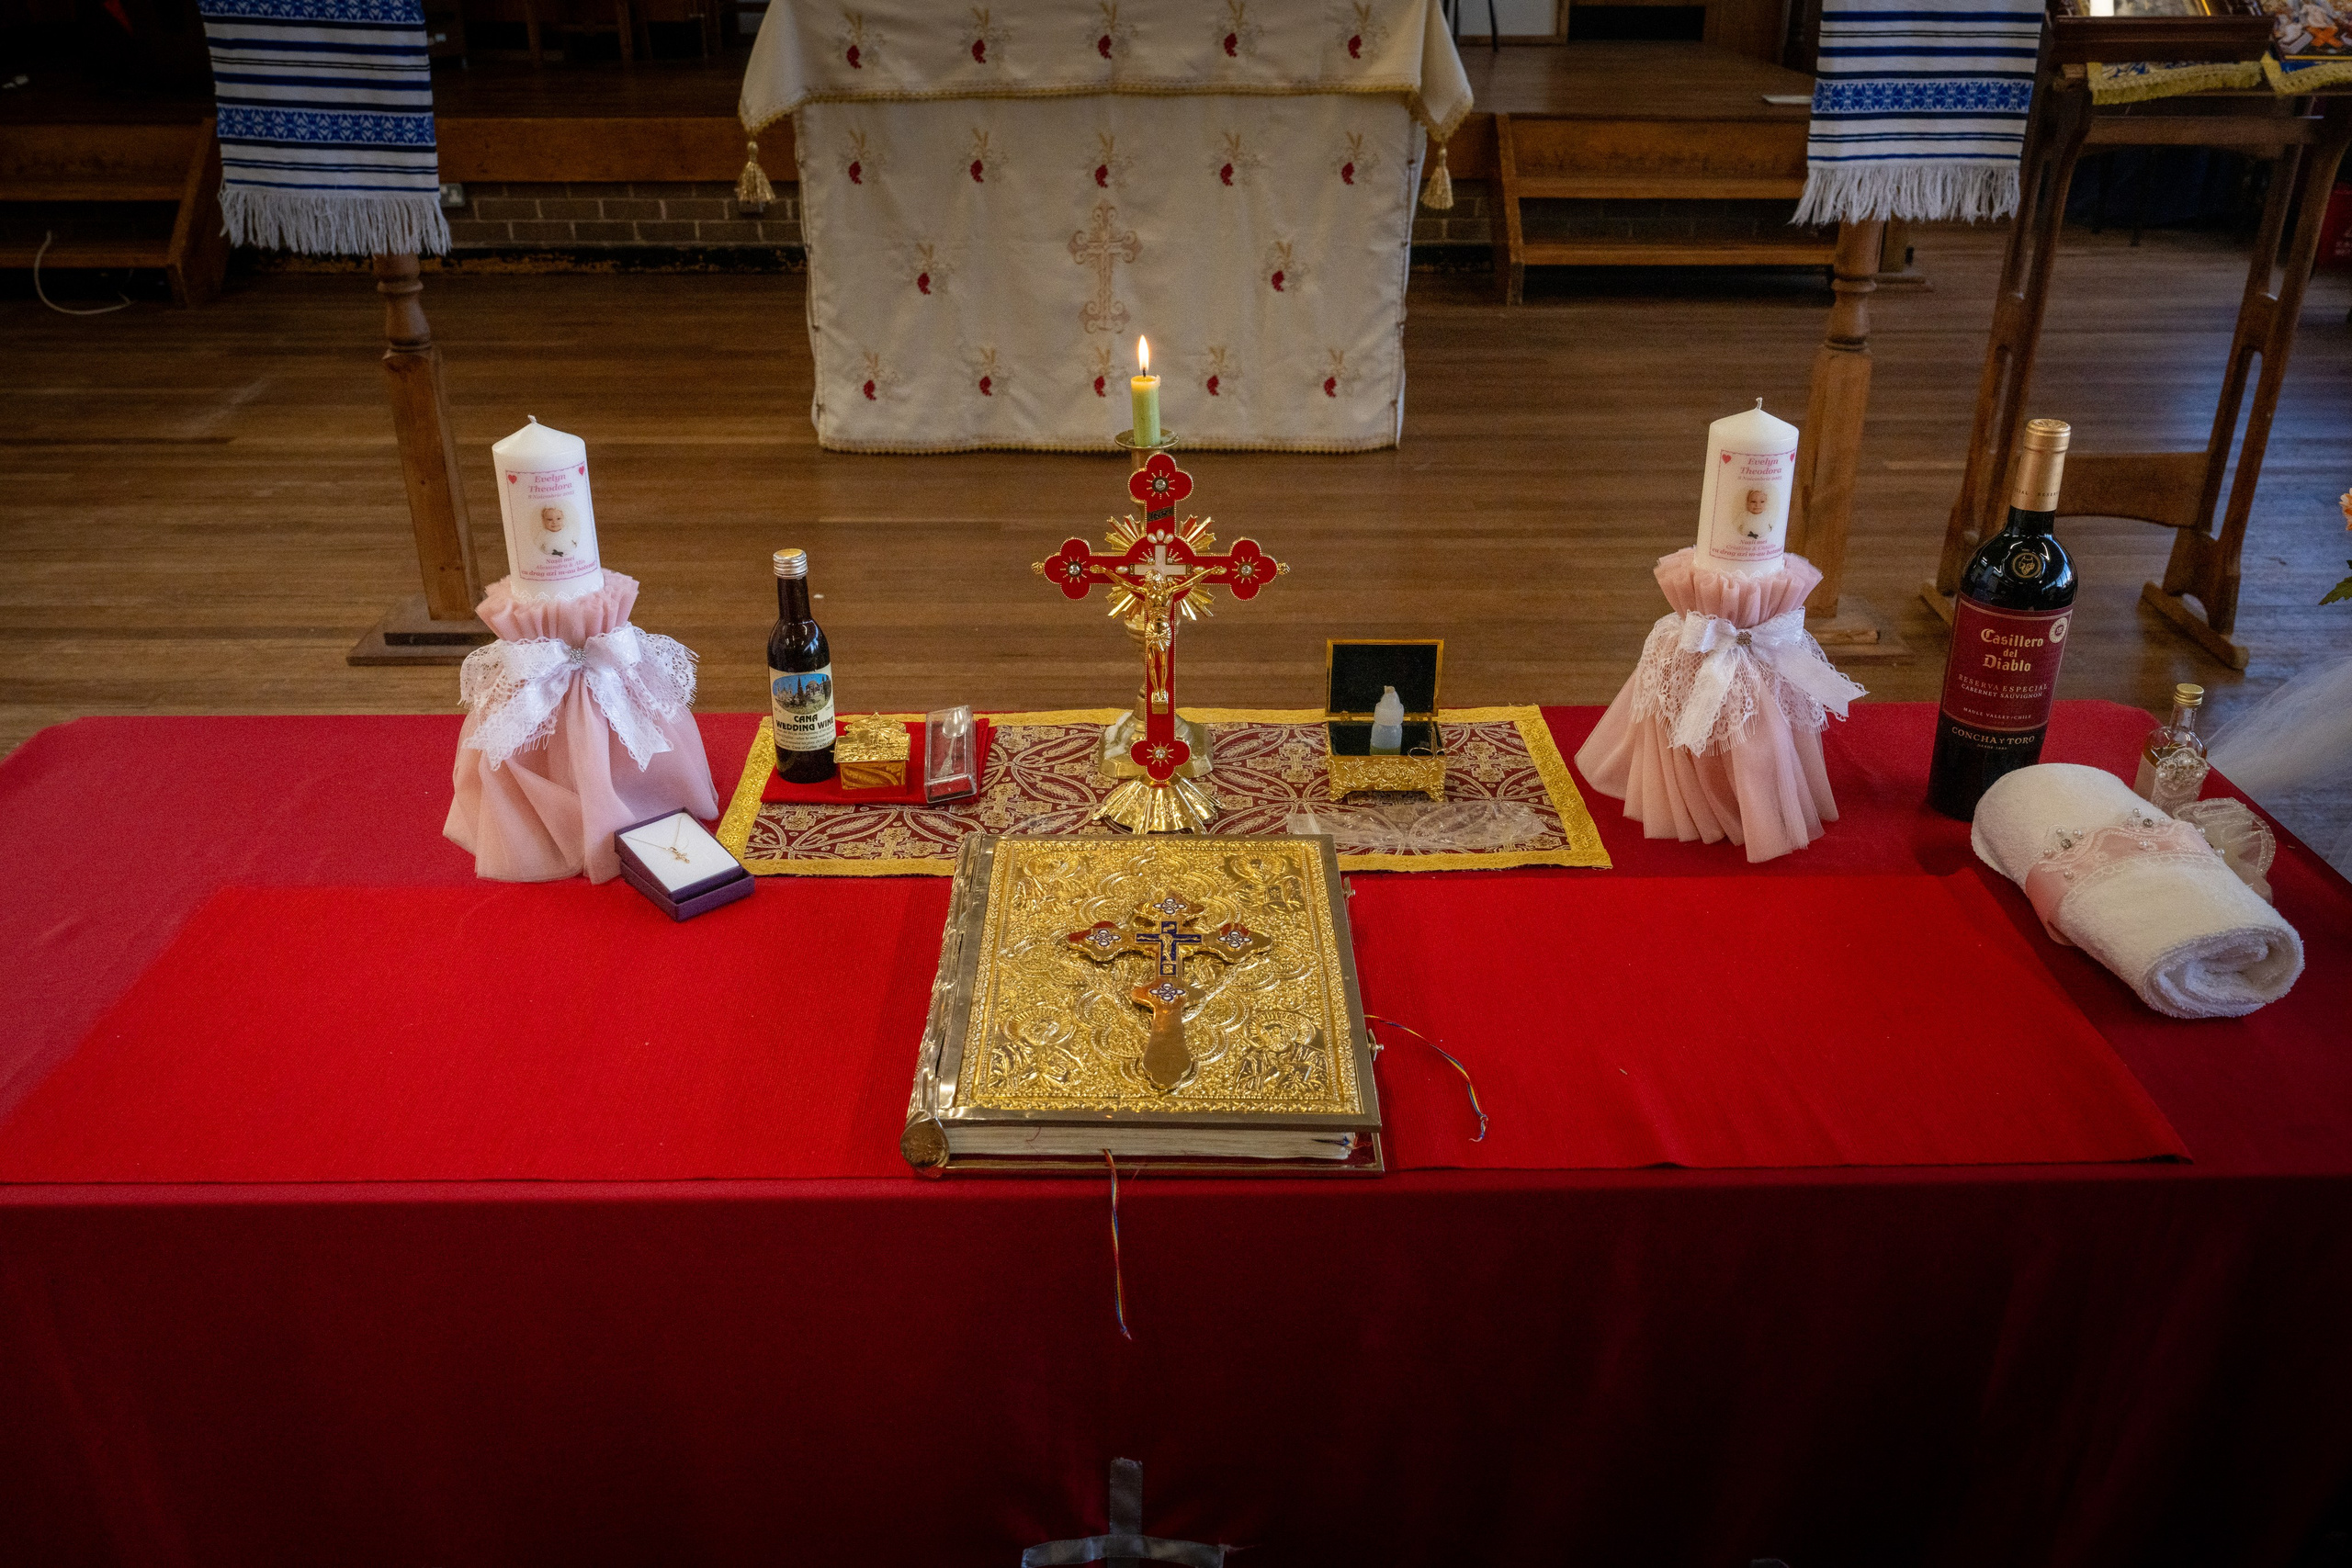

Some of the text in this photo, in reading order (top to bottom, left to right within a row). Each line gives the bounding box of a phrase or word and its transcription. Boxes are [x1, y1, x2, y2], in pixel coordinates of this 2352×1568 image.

[1747, 457, 1779, 467] Evelyn
[1740, 467, 1782, 475] Theodora
[535, 473, 566, 483] Evelyn
[528, 482, 572, 493] Theodora
[1720, 548, 1736, 557] drag
[1980, 628, 2044, 648] Casillero
[2003, 649, 2018, 658] del
[1983, 654, 2031, 672] Diablo
[1958, 673, 2047, 693] RESERVA ESPECIAL
[1961, 683, 1997, 697] CABERNET
[1963, 706, 1984, 716] MAULE
[794, 714, 818, 723] CANA
[775, 719, 815, 732] WEDDING
[817, 716, 834, 729] WINE
[1951, 727, 1997, 744] CONCHA
[2007, 735, 2035, 745] TORO
